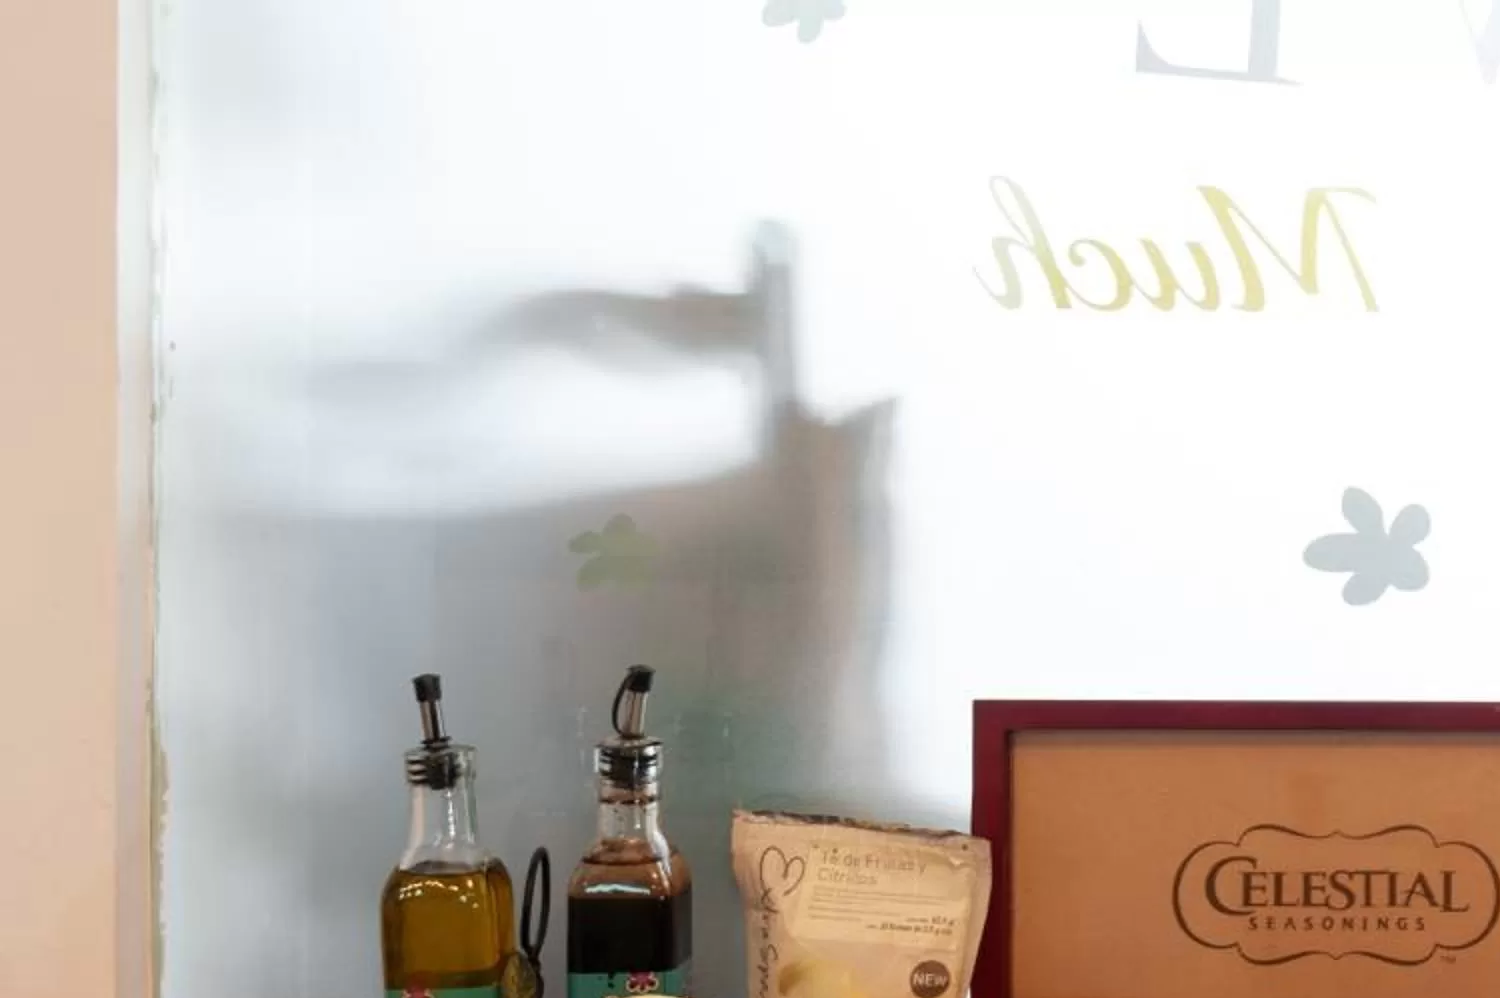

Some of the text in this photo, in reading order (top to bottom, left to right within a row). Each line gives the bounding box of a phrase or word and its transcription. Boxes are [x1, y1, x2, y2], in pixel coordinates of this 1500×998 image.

[1205, 856, 1470, 915] CELESTIAL
[1249, 916, 1425, 931] SEASONINGS
[912, 973, 947, 987] NEW
